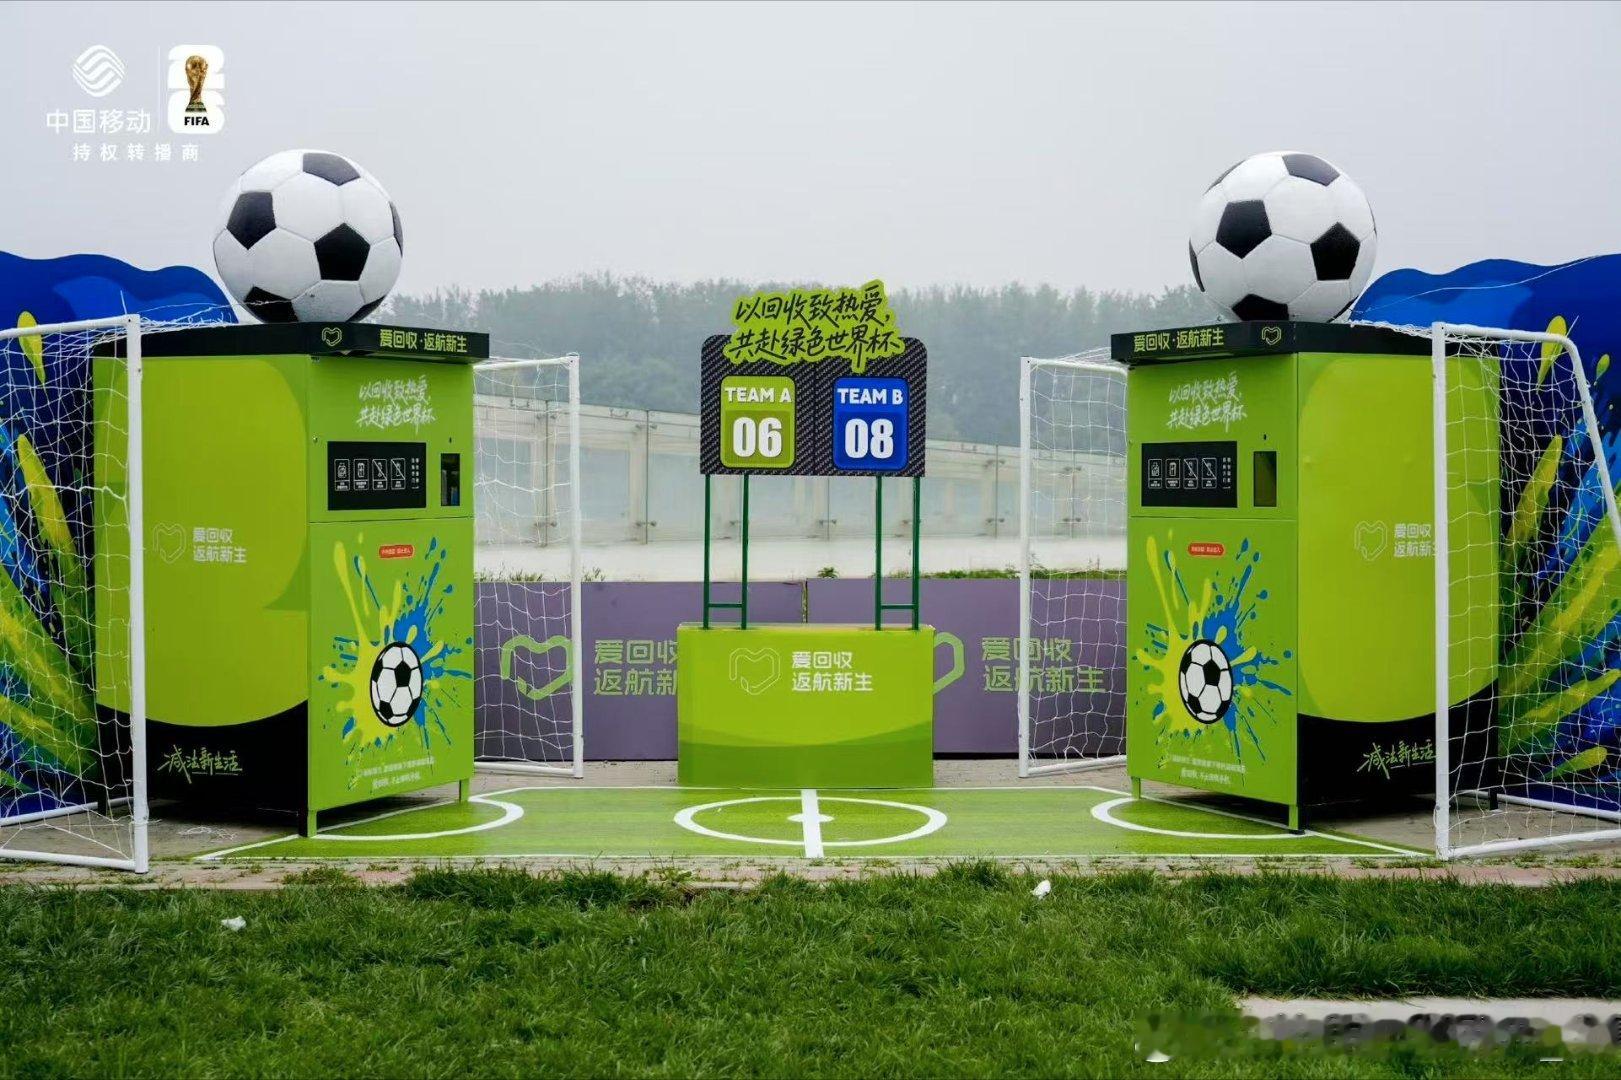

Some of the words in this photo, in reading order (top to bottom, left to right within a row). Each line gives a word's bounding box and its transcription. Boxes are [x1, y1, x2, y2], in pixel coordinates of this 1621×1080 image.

[729, 325, 900, 369] 共赴绿色世界杯
[725, 386, 775, 403] TEAM
[779, 388, 792, 403] A
[837, 388, 887, 405] TEAM
[892, 389, 903, 405] B
[732, 416, 782, 458] 06
[844, 418, 894, 459] 08
[193, 527, 233, 543] 爱回收
[1394, 523, 1432, 538] 爱回收
[193, 545, 247, 563] 返航新生
[594, 639, 678, 664] 爱回收
[791, 651, 853, 669] 爱回收
[791, 672, 873, 692] 返航新生
[157, 744, 243, 784] 减法新生活
